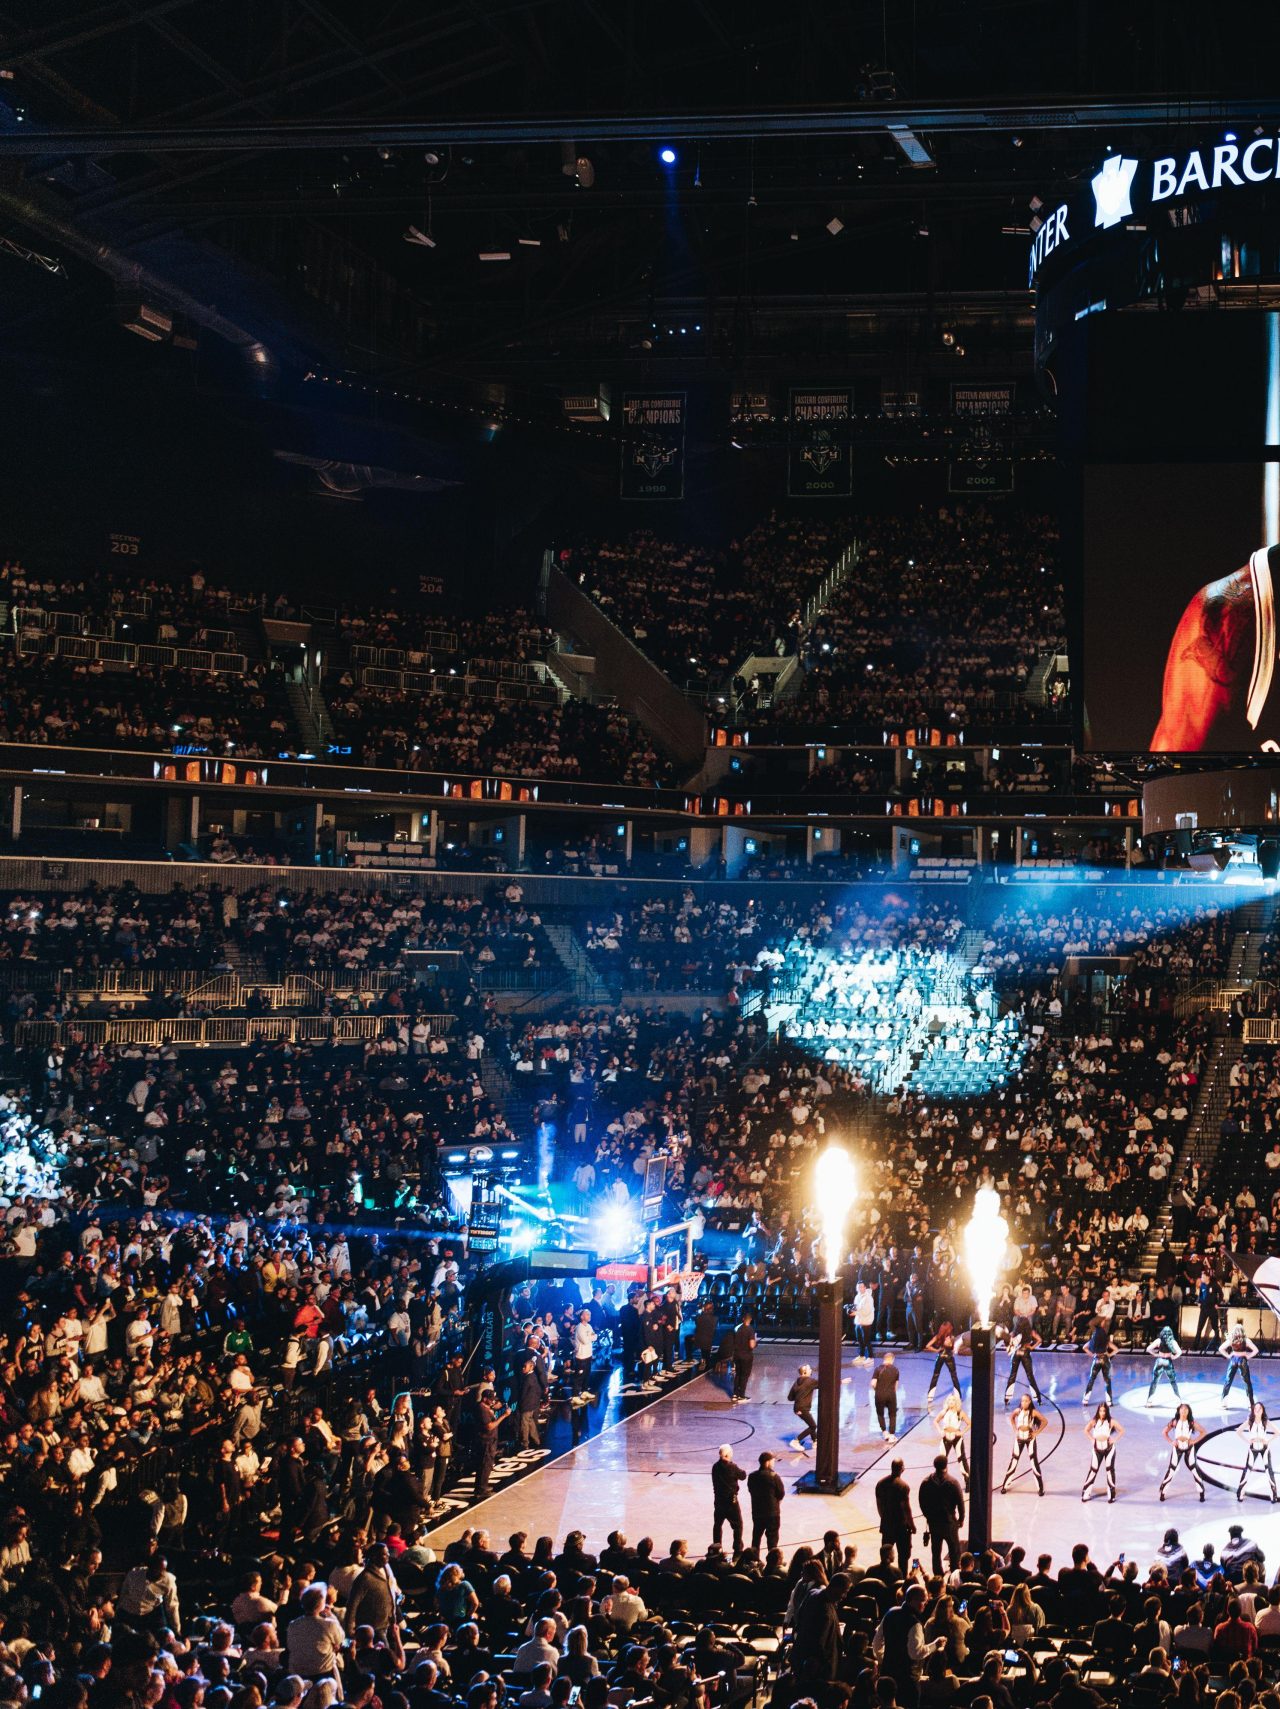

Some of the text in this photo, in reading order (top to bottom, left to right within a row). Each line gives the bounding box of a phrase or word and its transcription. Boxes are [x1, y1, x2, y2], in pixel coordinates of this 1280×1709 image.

[795, 405, 849, 421] CHAMPIONS
[966, 476, 996, 485] 2002
[110, 532, 142, 543] SECTION
[111, 541, 139, 555] 203
[419, 582, 444, 594] 204
[485, 1311, 494, 1350] BARCLAYS
